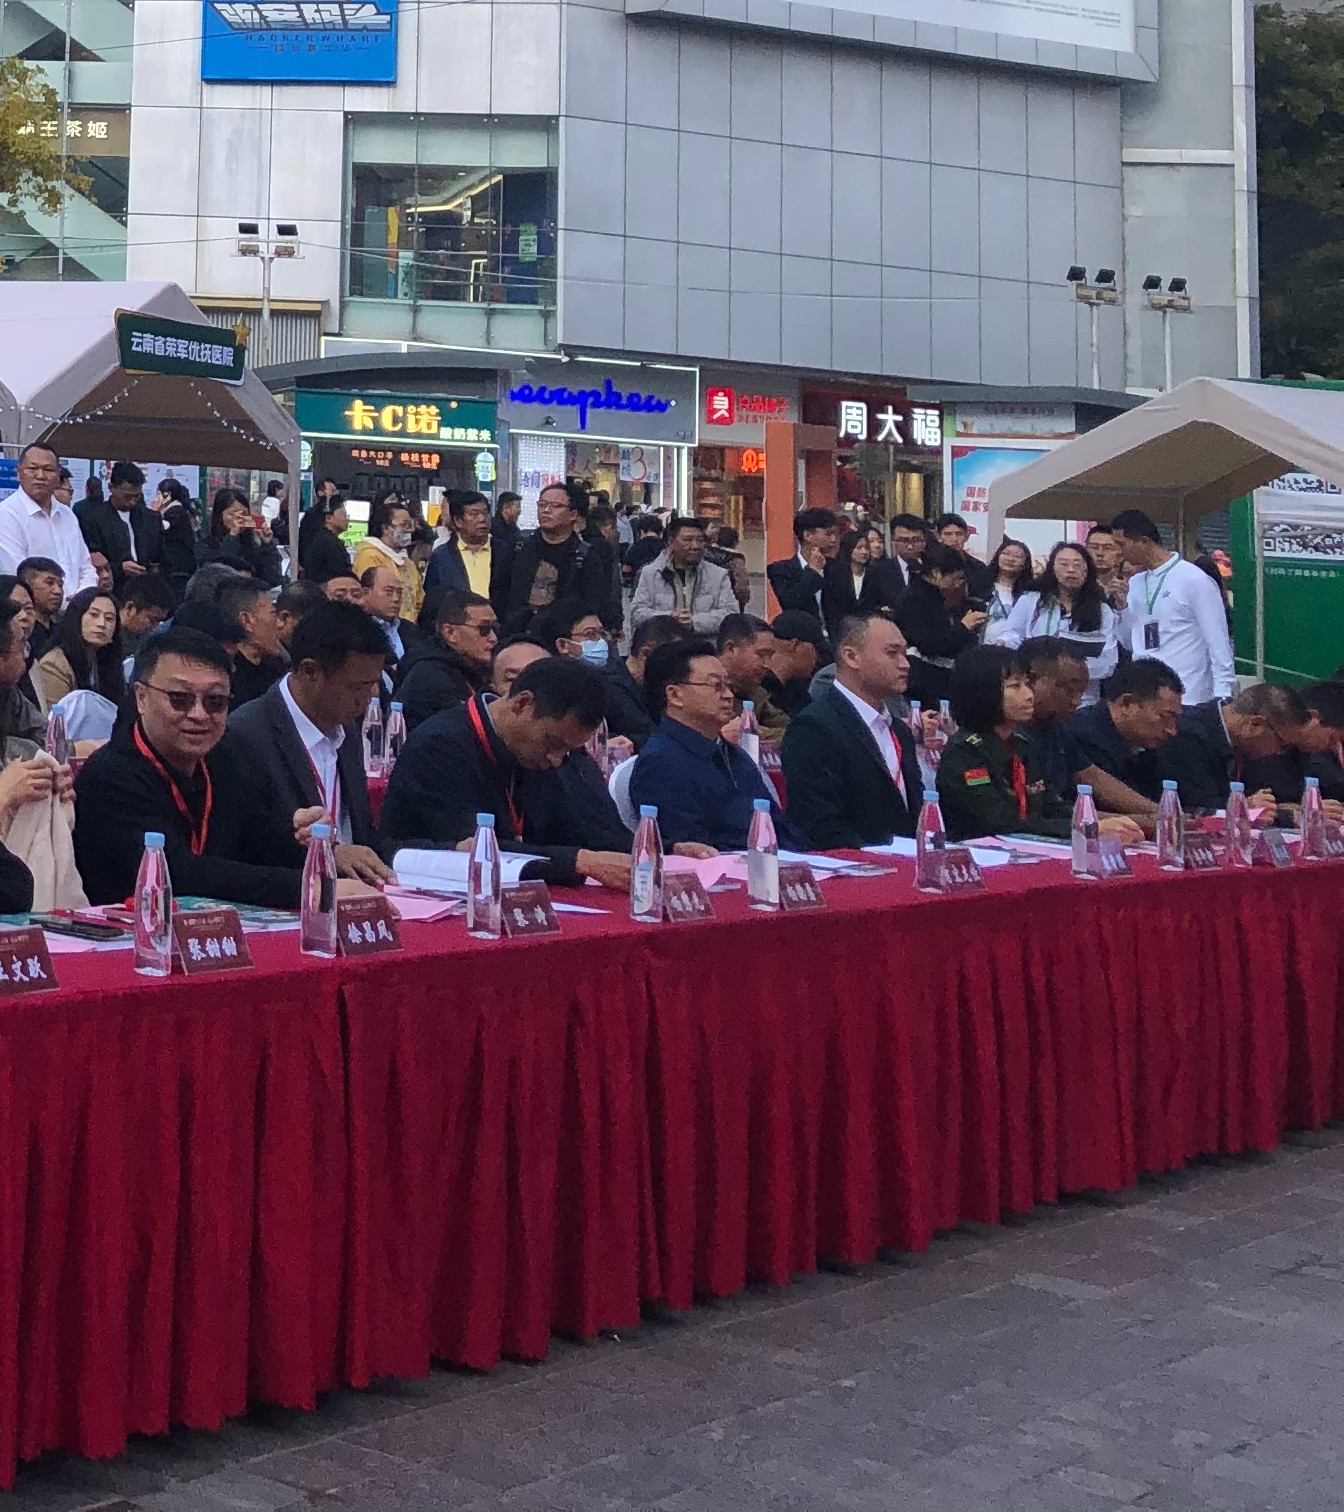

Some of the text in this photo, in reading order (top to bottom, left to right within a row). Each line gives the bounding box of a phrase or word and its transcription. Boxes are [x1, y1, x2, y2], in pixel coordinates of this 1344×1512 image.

[131, 331, 234, 367] 云南省荣军优抚医院
[344, 399, 442, 434] 卡C诺
[839, 400, 942, 446] 周大福
